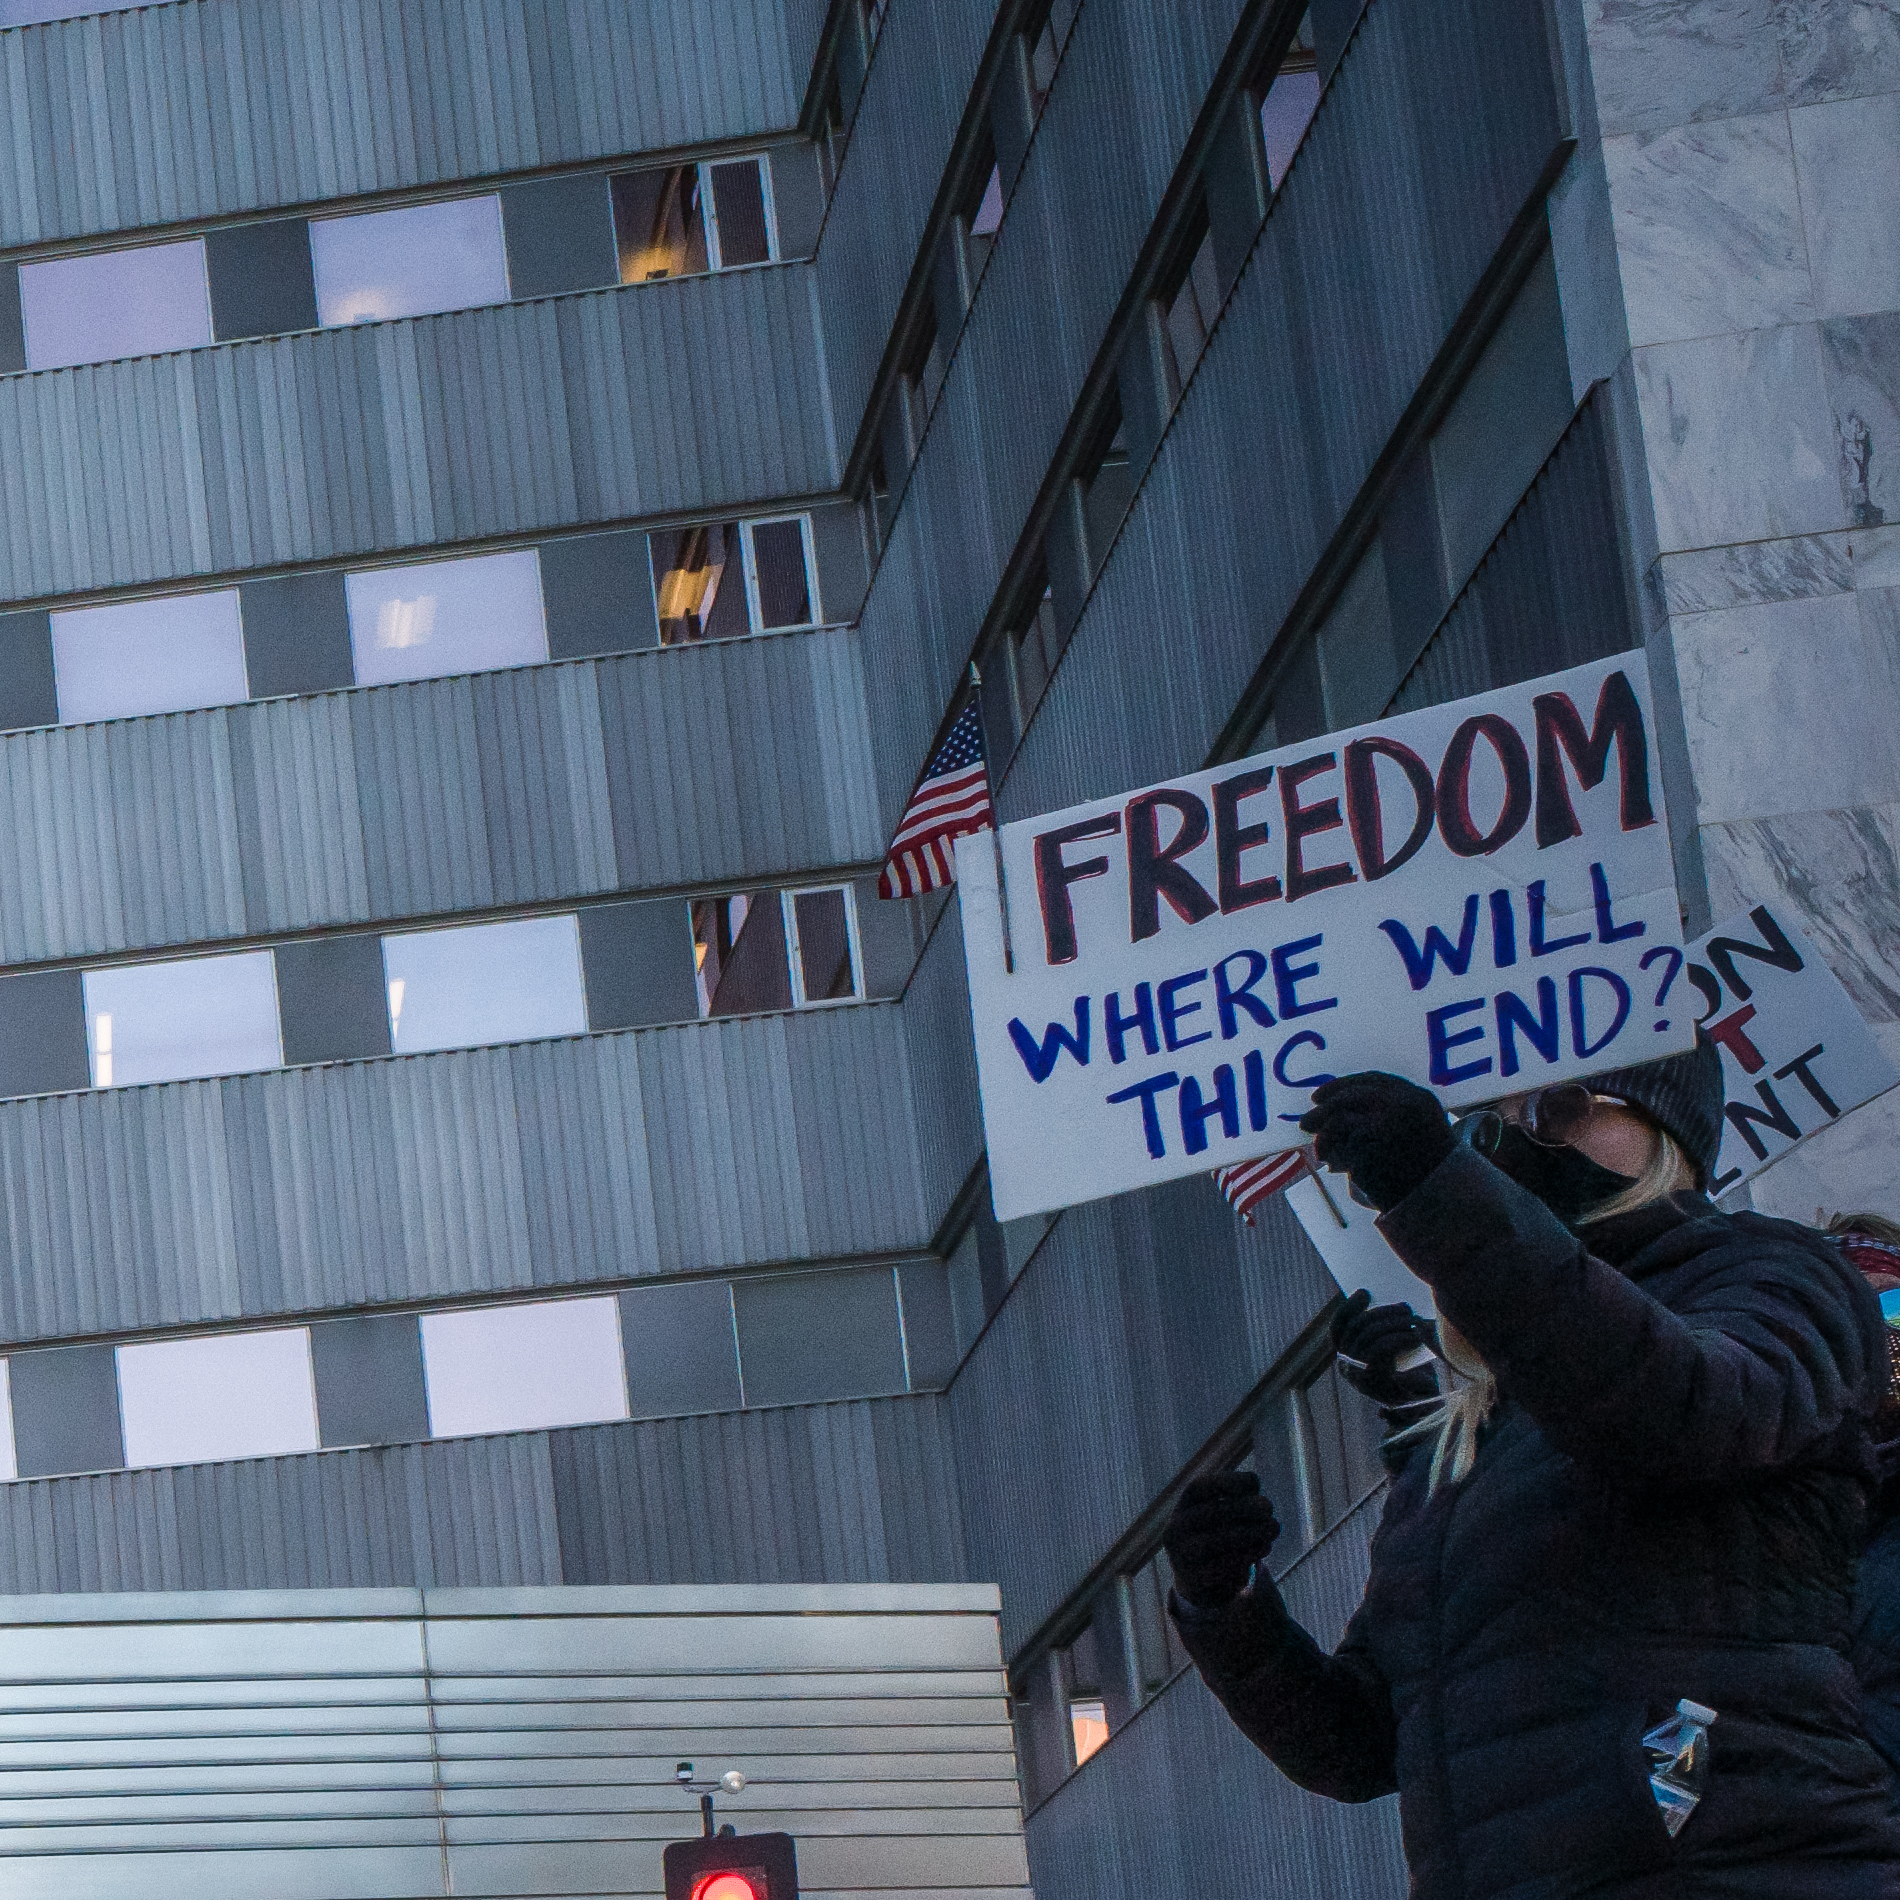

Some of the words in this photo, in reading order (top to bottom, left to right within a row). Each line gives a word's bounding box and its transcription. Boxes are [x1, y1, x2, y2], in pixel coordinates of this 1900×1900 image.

[1034, 670, 1655, 965] FREEDOM
[1007, 932, 1338, 1083] WHERE
[1379, 862, 1647, 991] WILL
[1107, 1029, 1338, 1160] THIS
[1426, 945, 1684, 1087] END?
